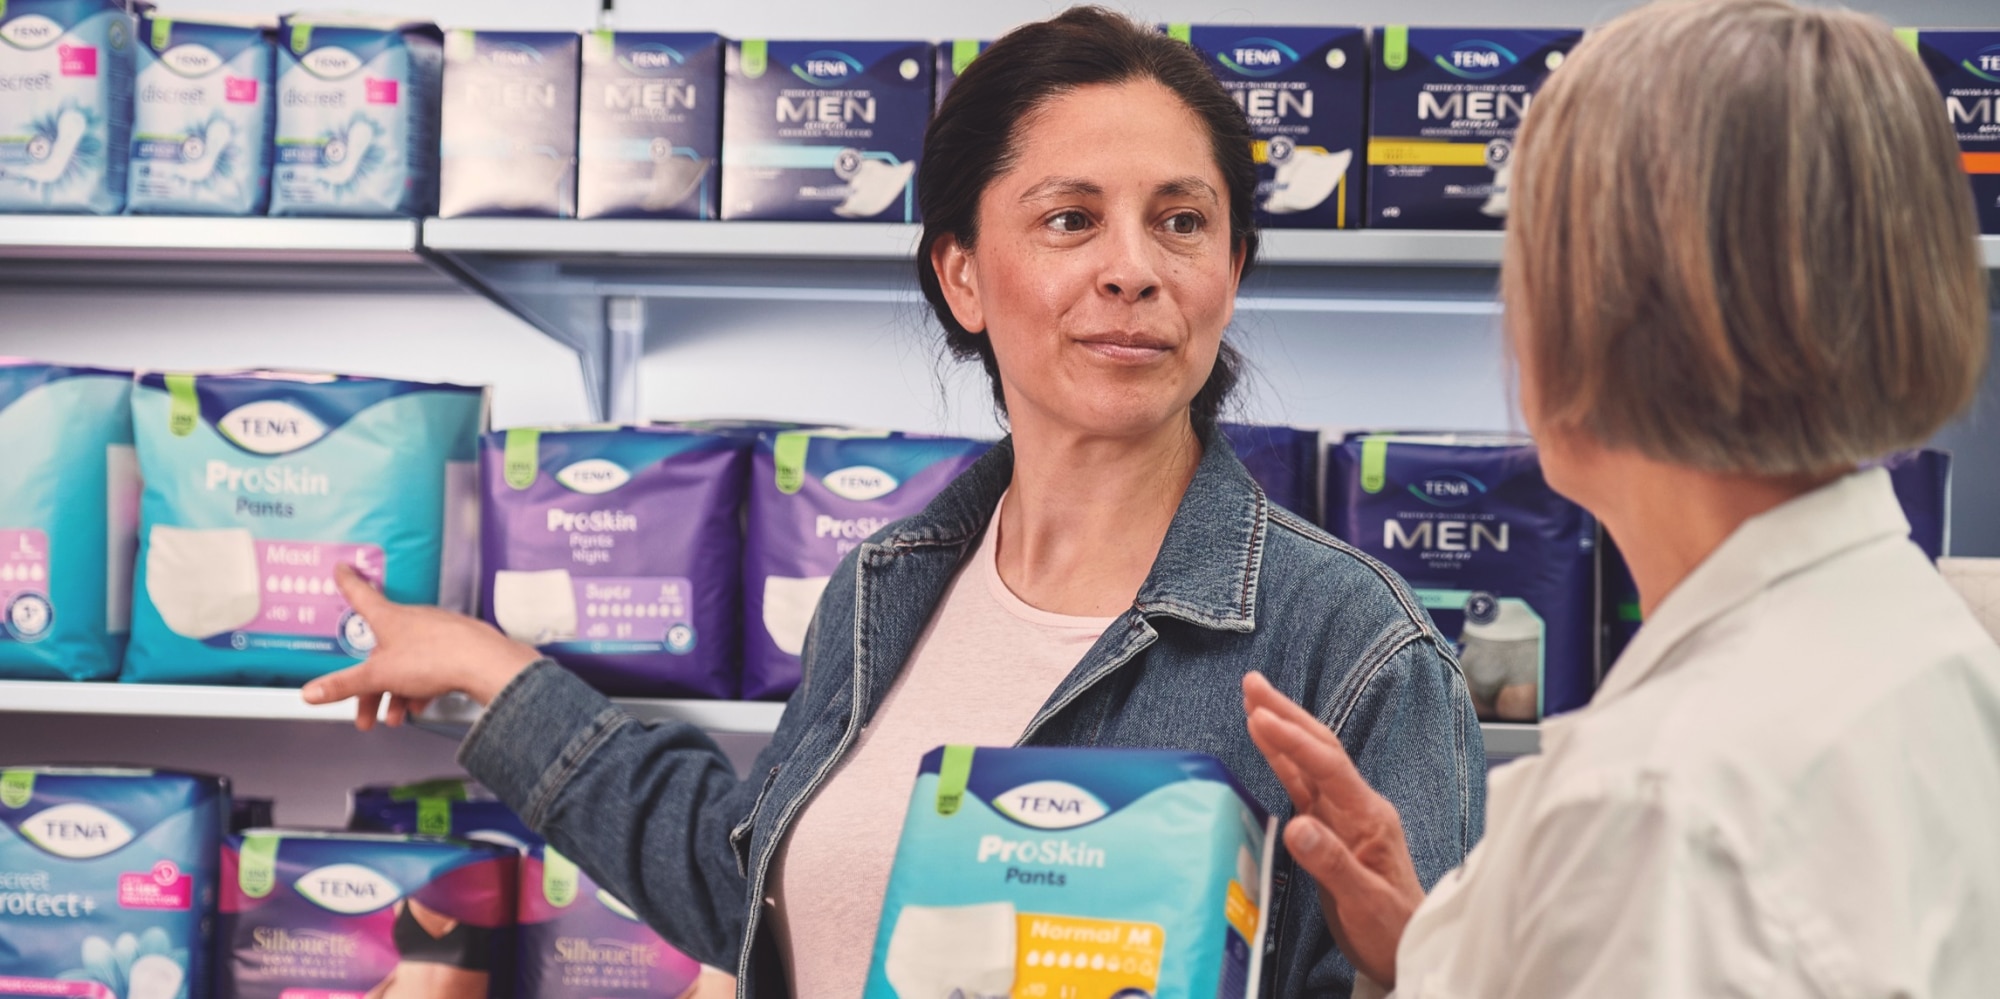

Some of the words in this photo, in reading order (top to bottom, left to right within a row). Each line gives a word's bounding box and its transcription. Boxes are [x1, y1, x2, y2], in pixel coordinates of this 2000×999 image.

[1235, 48, 1281, 65] TENA
[1453, 50, 1499, 67] TENA
[806, 60, 848, 76] TENA
[142, 84, 205, 107] discreet
[283, 88, 345, 108] discreet
[604, 85, 696, 110] MEN
[1418, 91, 1531, 120] MEN
[776, 97, 876, 123] MEN
[1946, 96, 2000, 124] M
[241, 417, 299, 437] TENA
[206, 460, 329, 496] ProSkin
[1425, 480, 1469, 496] TENA
[235, 496, 294, 519] Pants
[547, 508, 638, 533] ProSkin
[569, 533, 615, 549] Pants
[1383, 519, 1509, 552] MEN
[266, 545, 320, 567] Maxi
[572, 549, 610, 565] Night
[1017, 794, 1084, 816] TENA
[45, 821, 107, 840] TENA
[977, 835, 1105, 869] ProSkin
[1004, 867, 1066, 888] Pants
[319, 879, 377, 899] TENA
[252, 926, 358, 958] Silhouette
[1030, 920, 1120, 945] Normal
[1126, 927, 1153, 946] M
[554, 937, 660, 967] Silhouette
